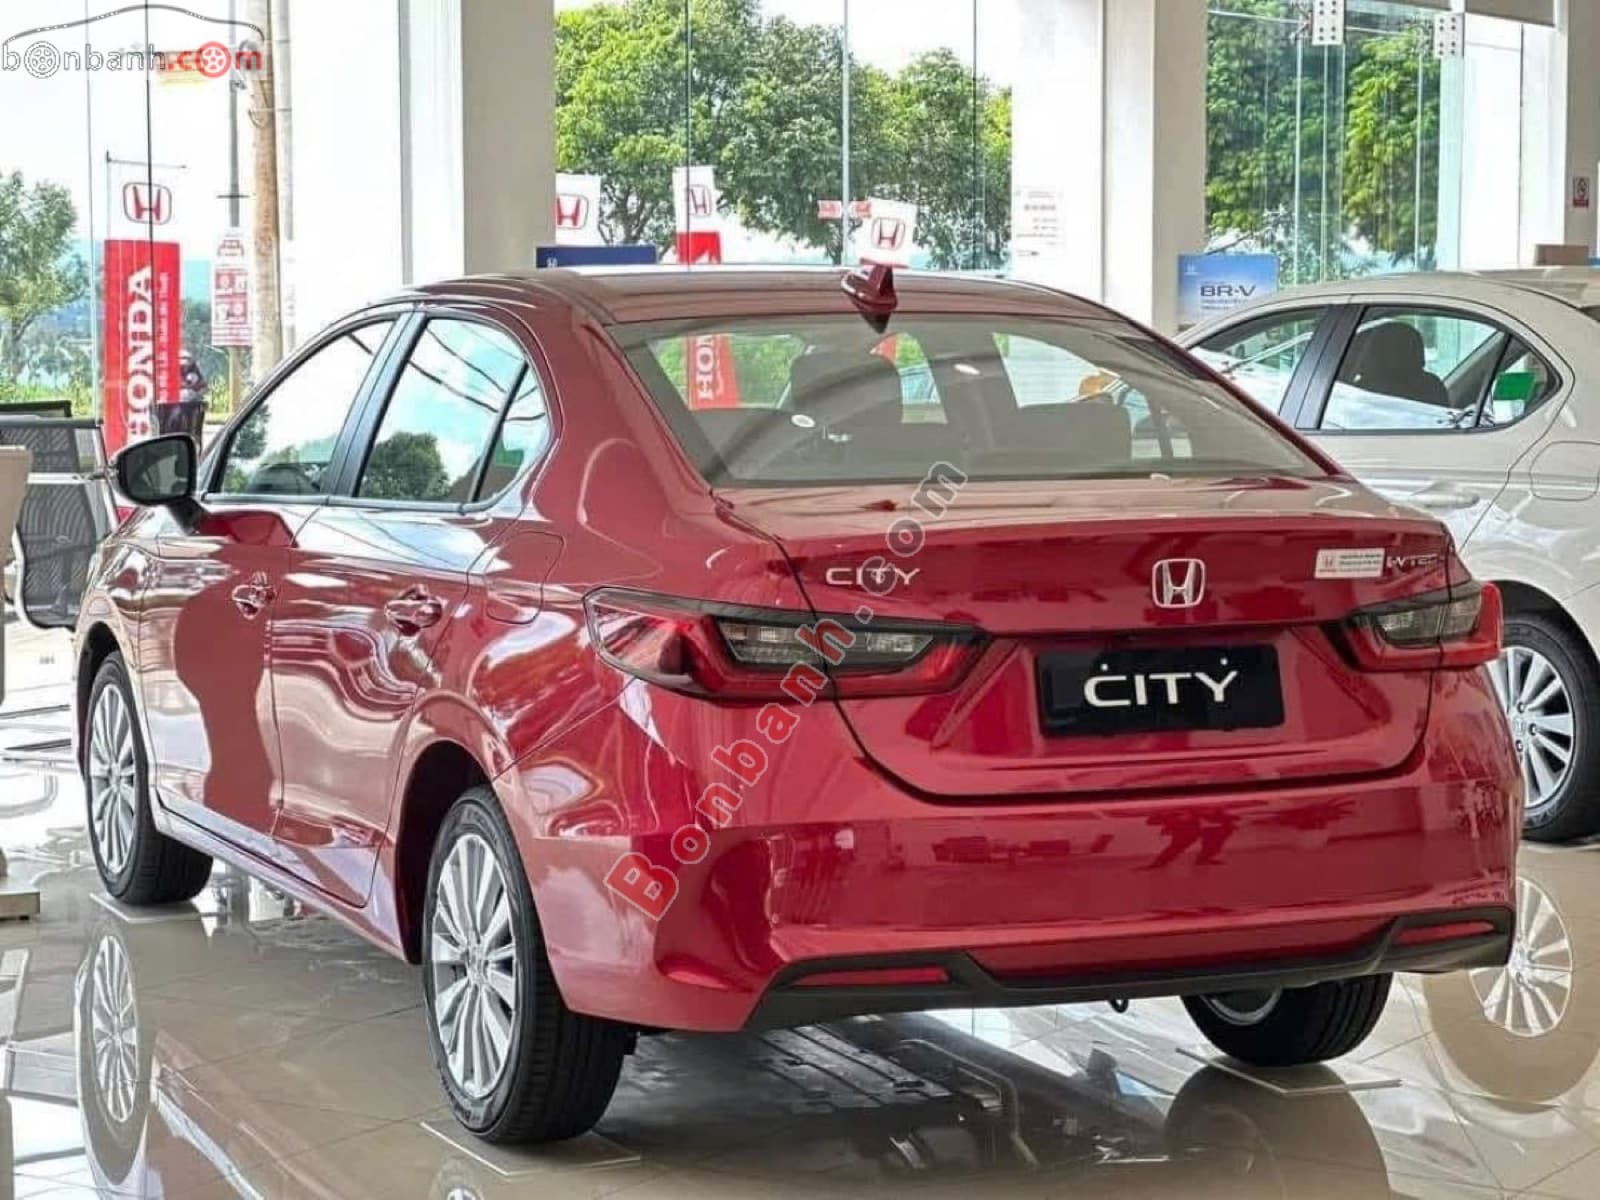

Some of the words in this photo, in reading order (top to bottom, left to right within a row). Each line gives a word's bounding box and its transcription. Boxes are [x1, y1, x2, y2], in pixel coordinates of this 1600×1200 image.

[126, 265, 154, 442] HONDA
[826, 567, 920, 585] CITY
[1084, 670, 1238, 707] CITY
